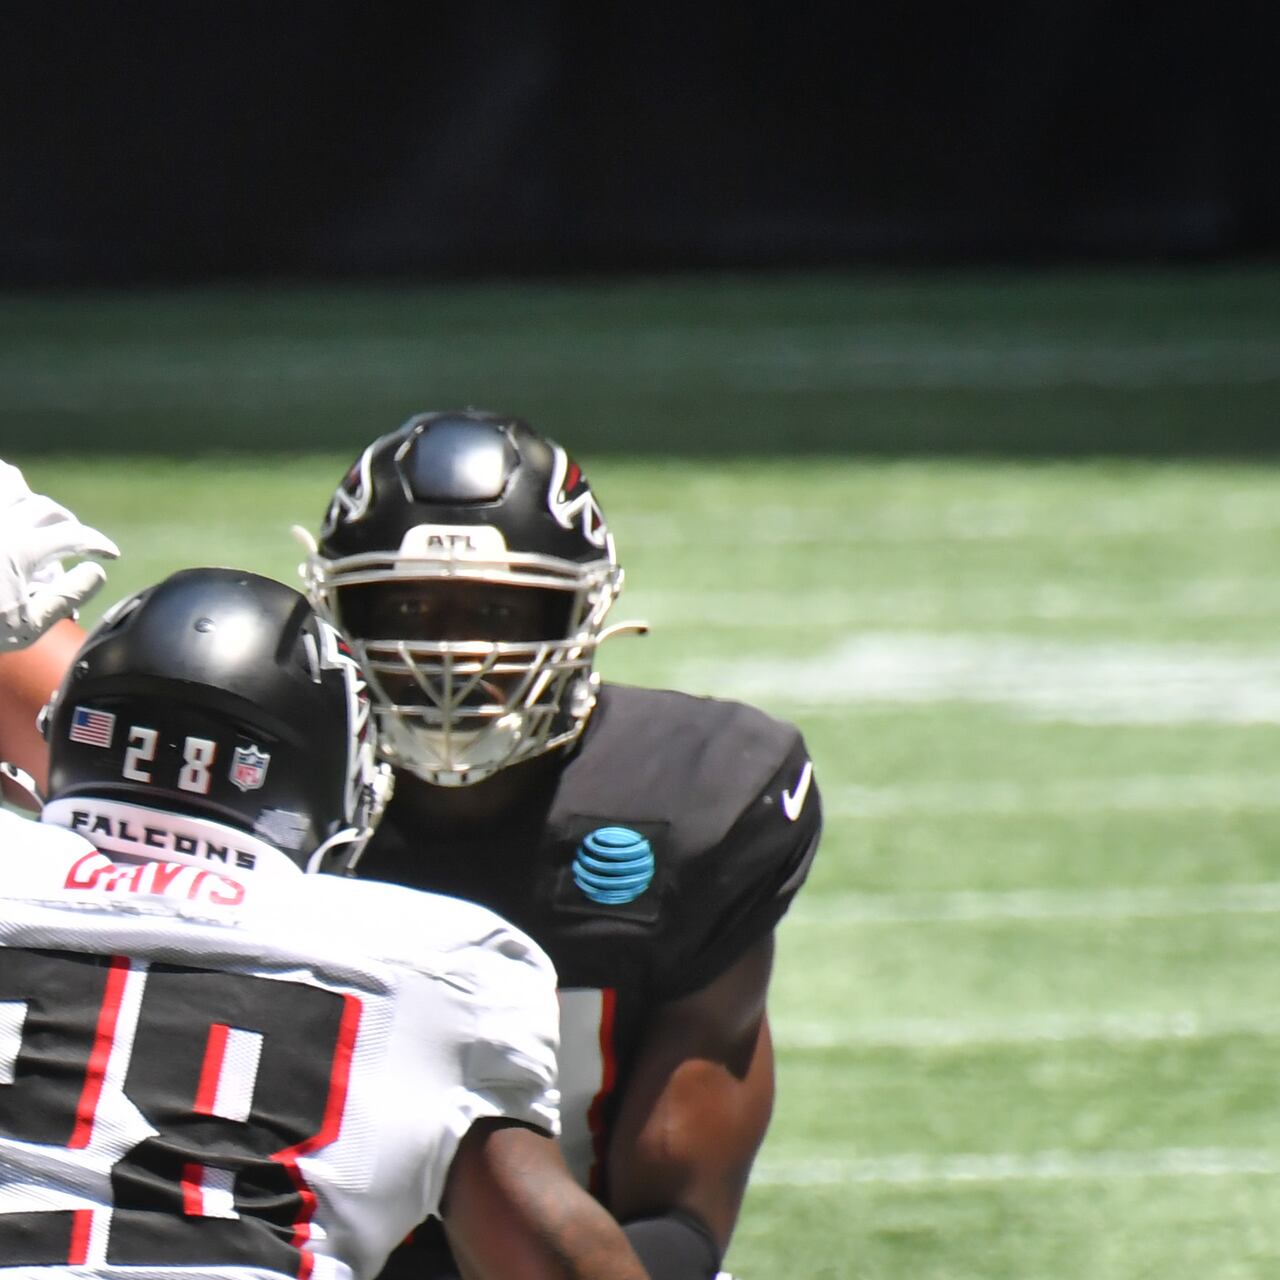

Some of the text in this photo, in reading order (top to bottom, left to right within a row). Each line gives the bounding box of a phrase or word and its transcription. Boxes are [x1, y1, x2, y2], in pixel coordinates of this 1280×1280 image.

[427, 534, 476, 552] ATL
[122, 726, 217, 795] 28
[71, 811, 256, 870] FALCONS
